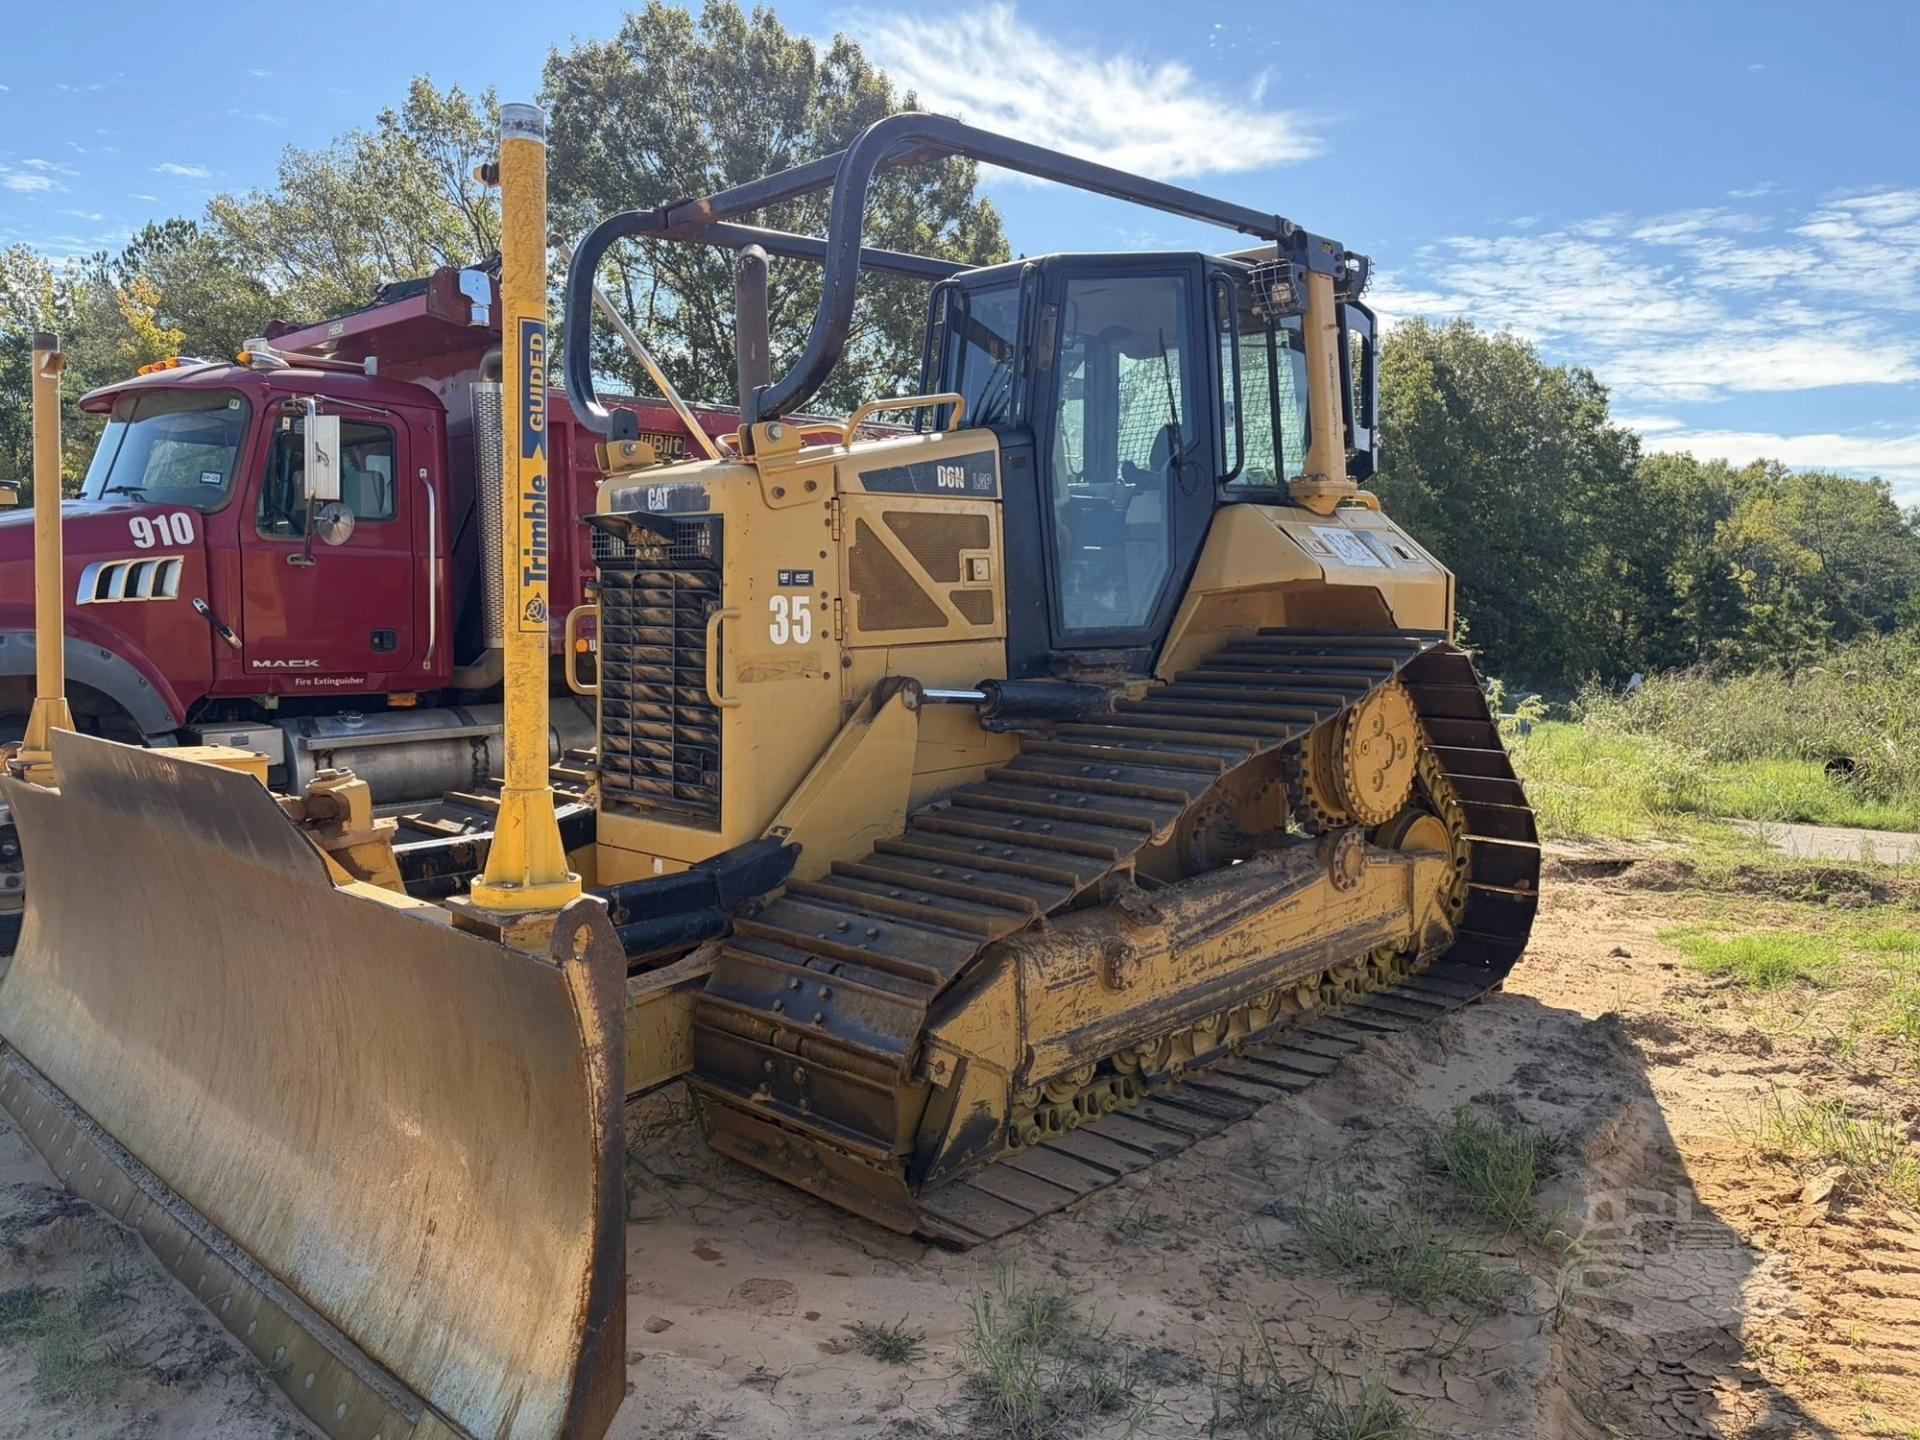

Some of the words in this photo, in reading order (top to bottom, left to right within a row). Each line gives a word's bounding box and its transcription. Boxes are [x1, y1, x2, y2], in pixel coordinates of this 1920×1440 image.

[529, 332, 545, 432] GUIDED
[937, 465, 965, 489] D6N
[648, 487, 670, 510] CAT
[129, 512, 195, 549] 910
[523, 474, 547, 587] Trimble
[769, 594, 812, 645] 35
[252, 659, 320, 668] MACK
[295, 677, 312, 686] Fire
[314, 676, 365, 687] Extinguisher
